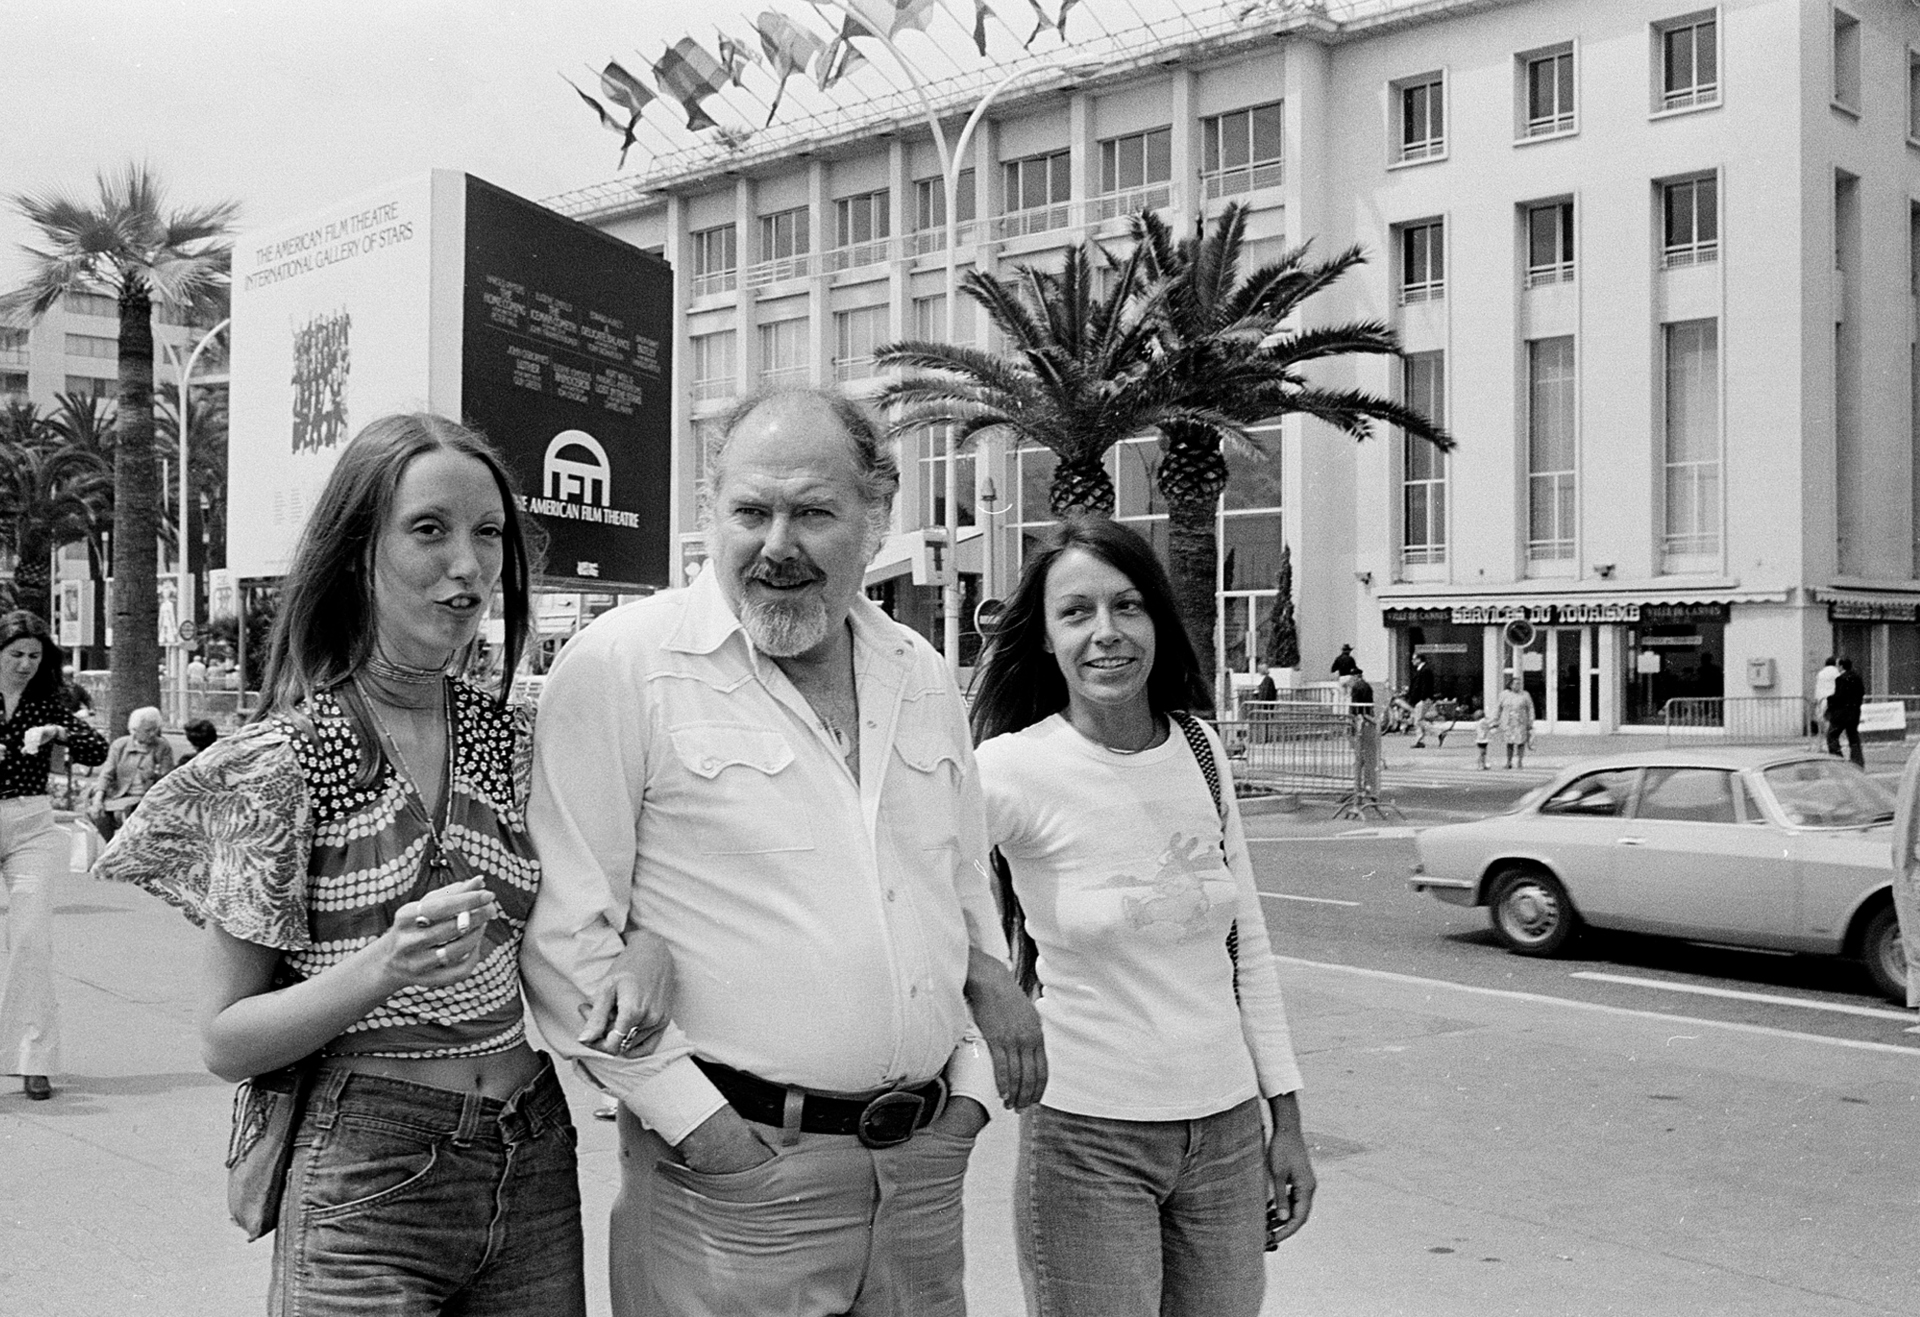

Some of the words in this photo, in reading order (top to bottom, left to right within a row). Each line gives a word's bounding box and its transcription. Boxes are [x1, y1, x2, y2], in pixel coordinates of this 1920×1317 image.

[244, 255, 314, 291] INTERNATIONAL
[315, 238, 360, 269] GALLERY
[362, 233, 377, 254] OF
[379, 221, 413, 249] STARS
[256, 246, 273, 266] THE
[274, 228, 322, 261] AMERICAN
[325, 219, 349, 243] FILM
[350, 201, 399, 234] THEATRE
[529, 497, 579, 520] AMERICAN
[581, 505, 602, 523] FILM
[603, 508, 640, 528] THEATRE
[1451, 607, 1525, 624] SERVICES
[1529, 607, 1551, 623] DU
[1556, 604, 1640, 623] TOURISME
